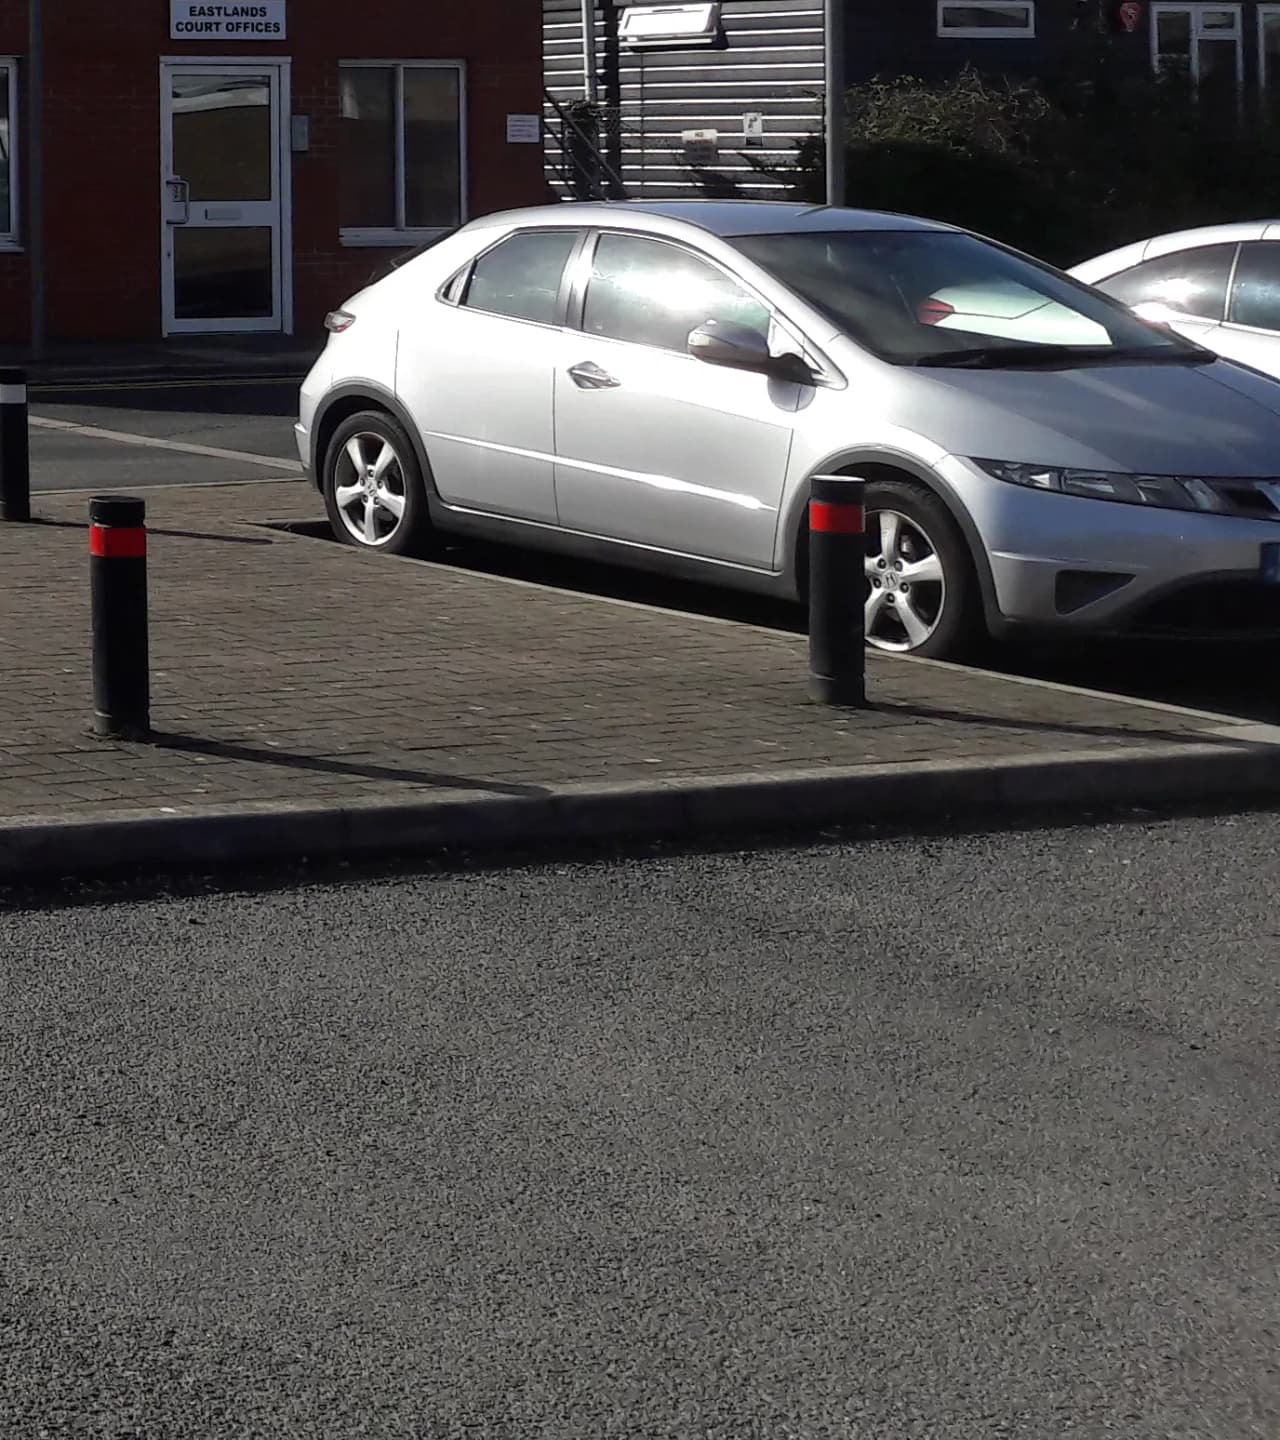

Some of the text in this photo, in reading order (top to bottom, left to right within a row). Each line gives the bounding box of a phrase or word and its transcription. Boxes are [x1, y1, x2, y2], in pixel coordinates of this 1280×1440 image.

[188, 5, 267, 17] EASTLANDS
[175, 21, 281, 33] COURT OFFICES
